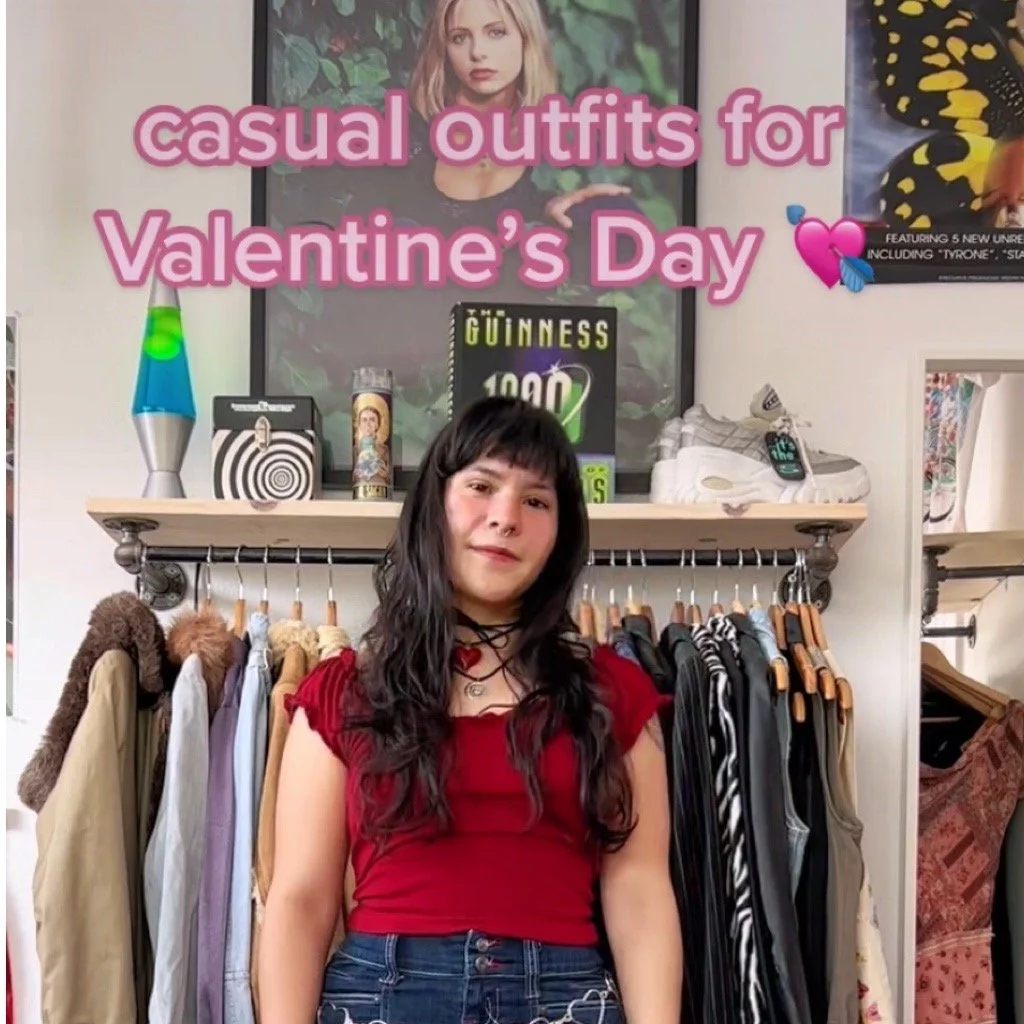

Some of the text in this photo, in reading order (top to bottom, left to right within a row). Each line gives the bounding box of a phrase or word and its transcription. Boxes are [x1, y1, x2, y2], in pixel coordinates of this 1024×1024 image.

[885, 233, 948, 244] FEATURING
[951, 233, 960, 244] 5
[962, 233, 990, 244] NEW
[866, 248, 934, 260] INCLUDING
